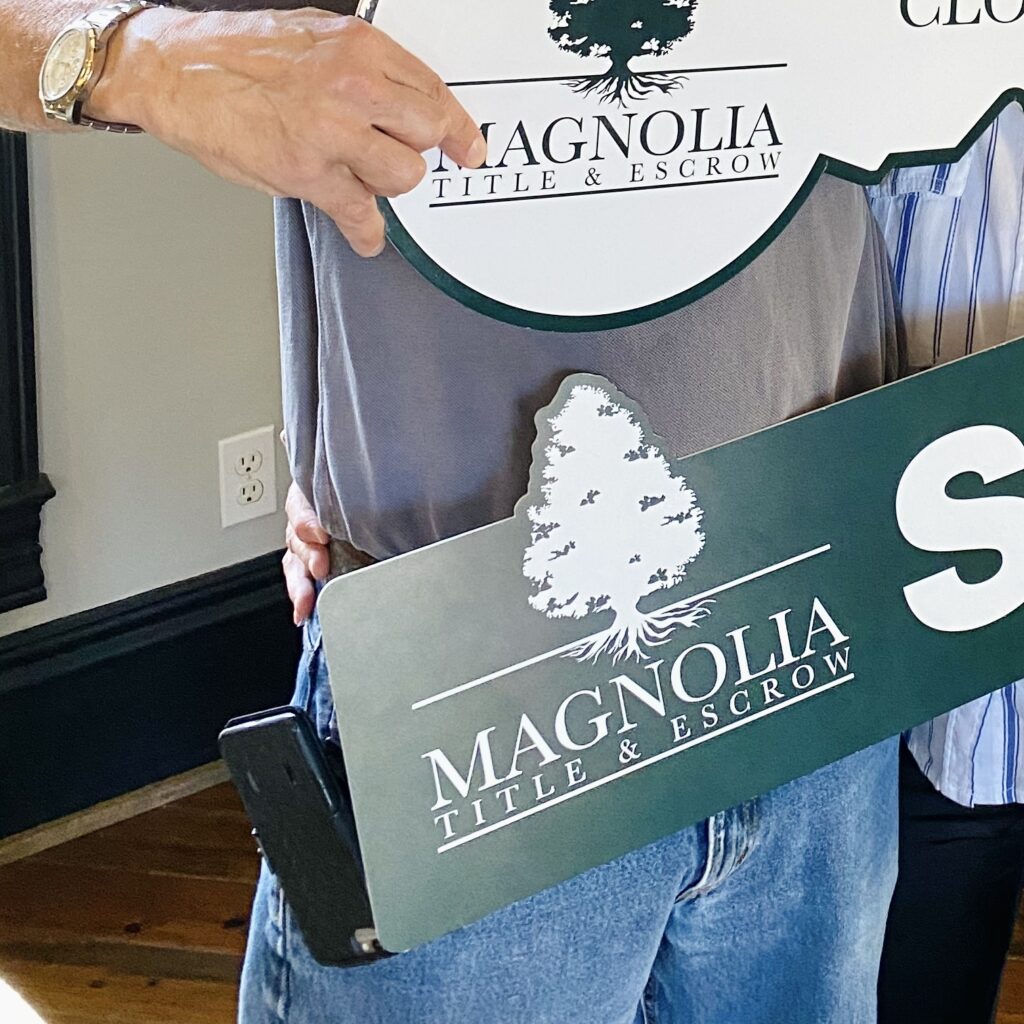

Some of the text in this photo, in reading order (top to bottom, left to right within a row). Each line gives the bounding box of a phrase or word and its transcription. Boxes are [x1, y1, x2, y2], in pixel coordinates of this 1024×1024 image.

[432, 151, 782, 198] TITLE & ESCROW
[422, 596, 850, 812] MAGNOLIA
[434, 646, 851, 839] TITLE & ESCROW
